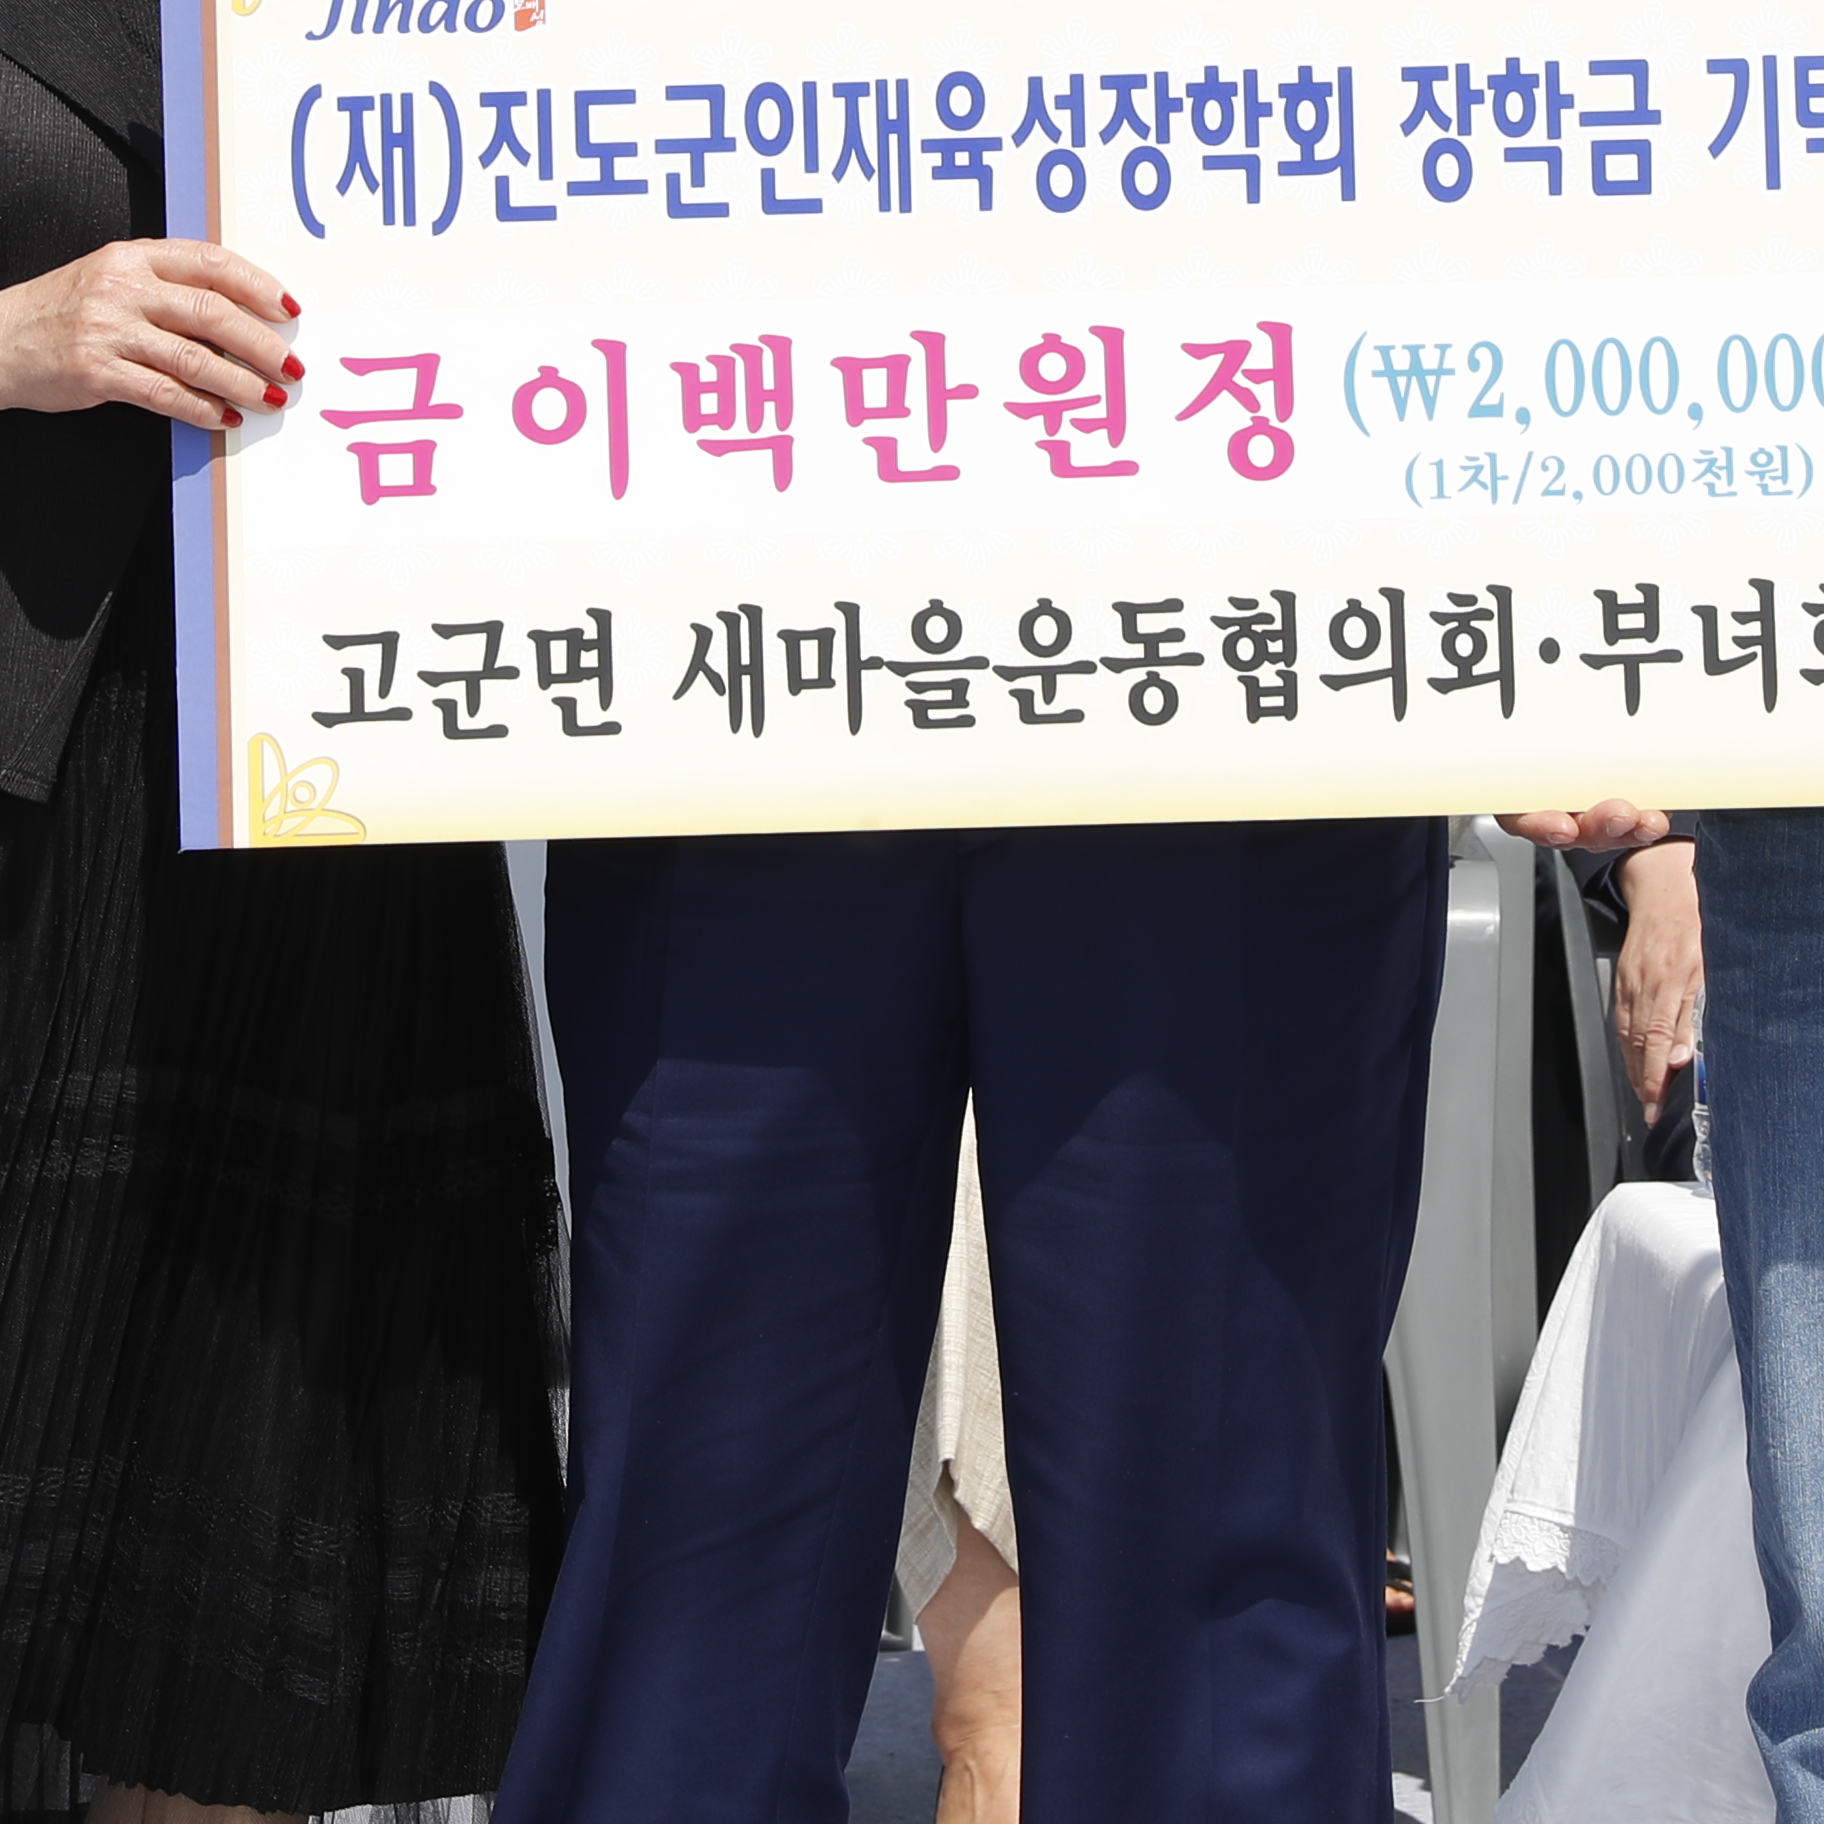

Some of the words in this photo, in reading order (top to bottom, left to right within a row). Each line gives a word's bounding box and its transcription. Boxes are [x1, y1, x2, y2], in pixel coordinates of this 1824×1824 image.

[290, 64, 1358, 239] (재)진도군인재육성장학회
[1400, 57, 1663, 203] 장학금
[1405, 443, 1815, 506] (1차/2,000천원)
[311, 607, 623, 741] 고군면
